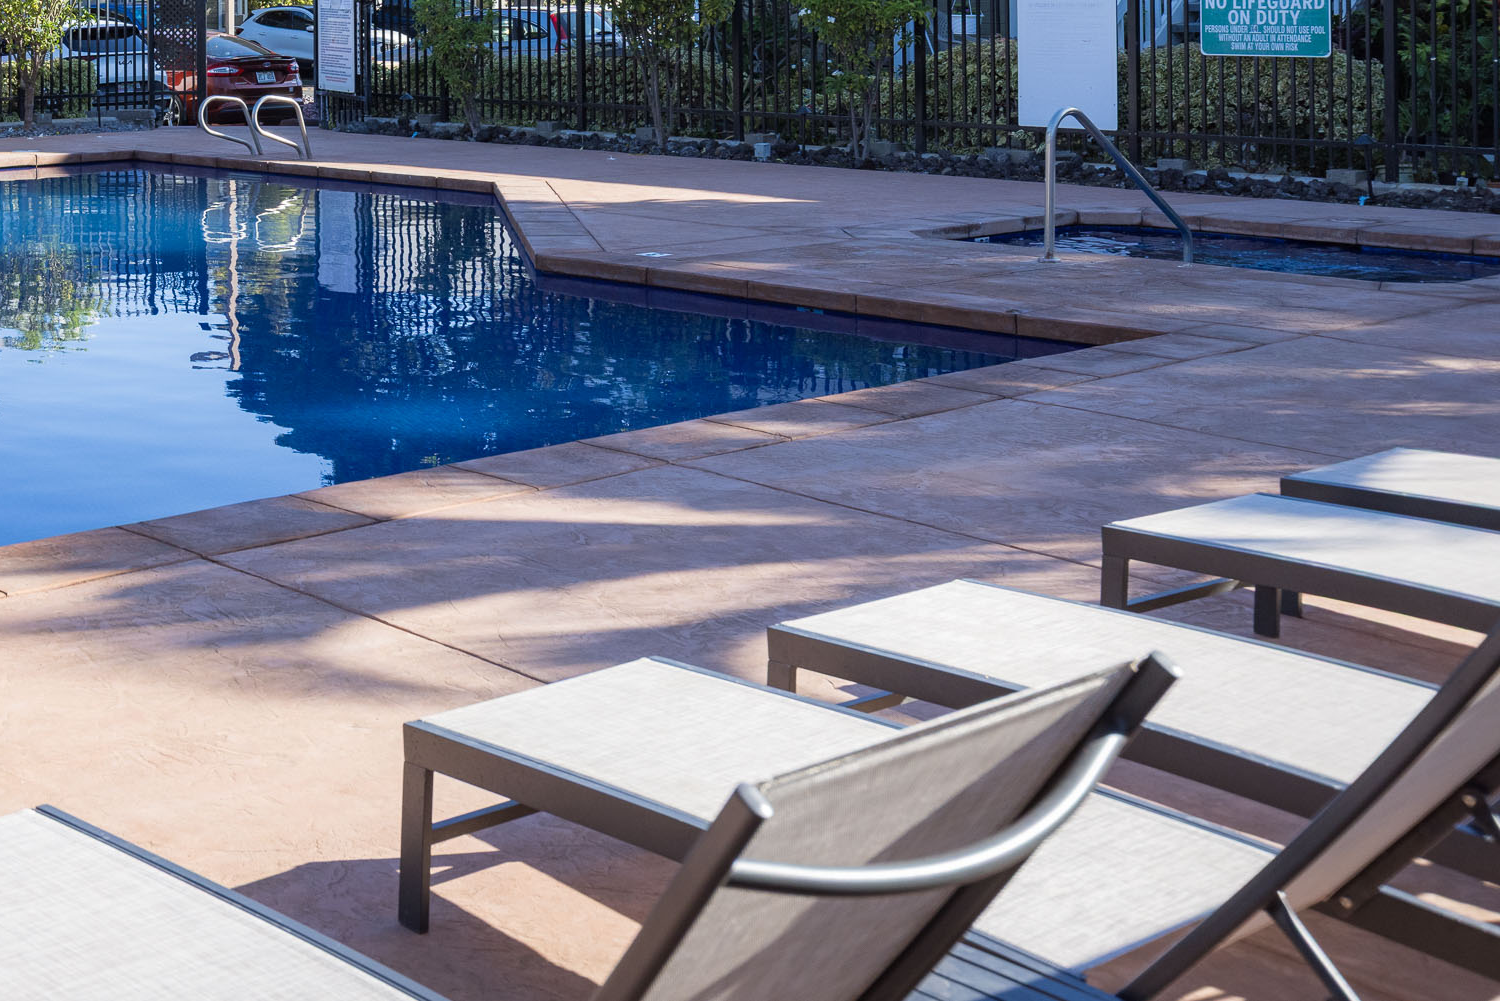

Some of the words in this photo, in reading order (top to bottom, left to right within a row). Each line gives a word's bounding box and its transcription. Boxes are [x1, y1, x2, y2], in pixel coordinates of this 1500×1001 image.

[1228, 10, 1250, 25] ON
[1257, 10, 1301, 26] DUTY
[1205, 25, 1229, 33] PERSONS
[1230, 25, 1248, 34] UNDER
[1263, 25, 1286, 34] SHOULD
[1286, 25, 1298, 34] NOT
[1299, 26, 1310, 34] USE
[1311, 26, 1326, 35] POOL
[1219, 33, 1243, 42] WITHOUT
[1243, 33, 1252, 42] AN
[1252, 34, 1269, 42] ADULT
[1270, 34, 1276, 42] IN
[1277, 34, 1312, 43] ATTENDANCE
[1231, 42, 1246, 50] SWIM
[1247, 42, 1254, 50] AT
[1255, 42, 1270, 51] YOUR
[1270, 42, 1285, 51] OWN
[1285, 43, 1299, 51] RISK
